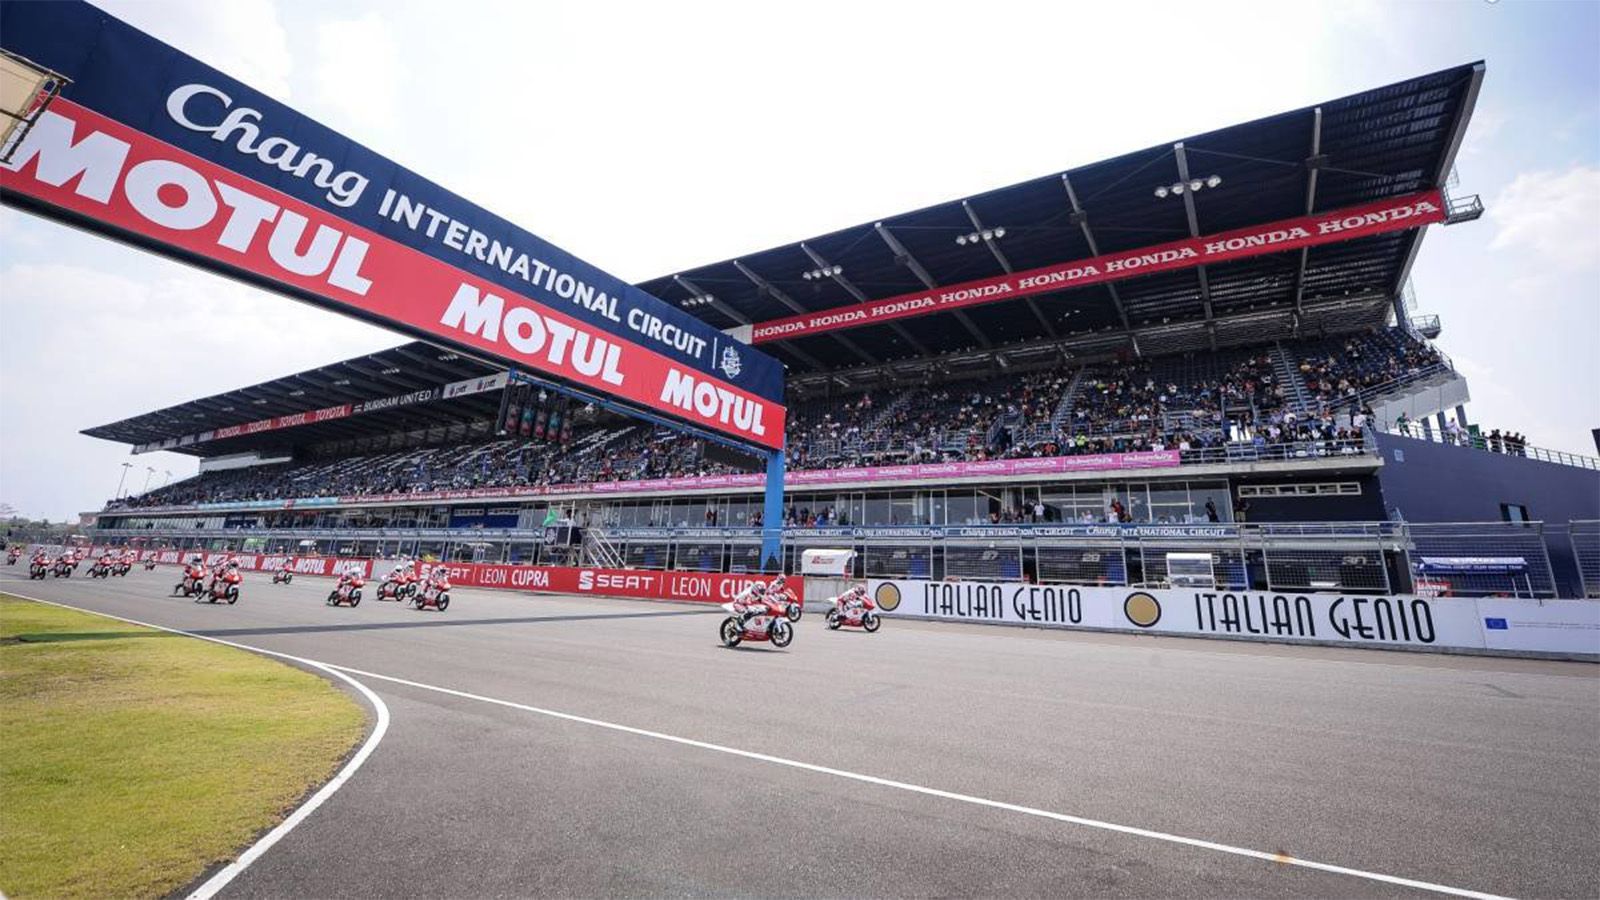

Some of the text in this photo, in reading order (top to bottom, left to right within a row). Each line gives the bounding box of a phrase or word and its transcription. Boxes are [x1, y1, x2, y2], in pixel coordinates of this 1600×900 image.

[167, 83, 707, 359] Chang INTERNATIONAL CIRCUIT
[0, 109, 766, 436] MOTUL MOTUL MOTUL
[754, 200, 1440, 338] HONDA HONDA HONDA HONDA HONDA HONDA HONDA HONDA
[400, 389, 432, 405] UNITED
[315, 405, 345, 421] TOYOTA
[1189, 528, 1226, 537] CIRCUIT
[295, 558, 326, 575] MOTUL
[479, 568, 508, 584] LEON
[511, 569, 550, 587] CUPRA
[596, 574, 655, 590] SEAT
[671, 576, 712, 598] LEON
[924, 583, 1082, 624] ITALIAN GENIO
[1194, 593, 1436, 644] ITALIAN GENIO
